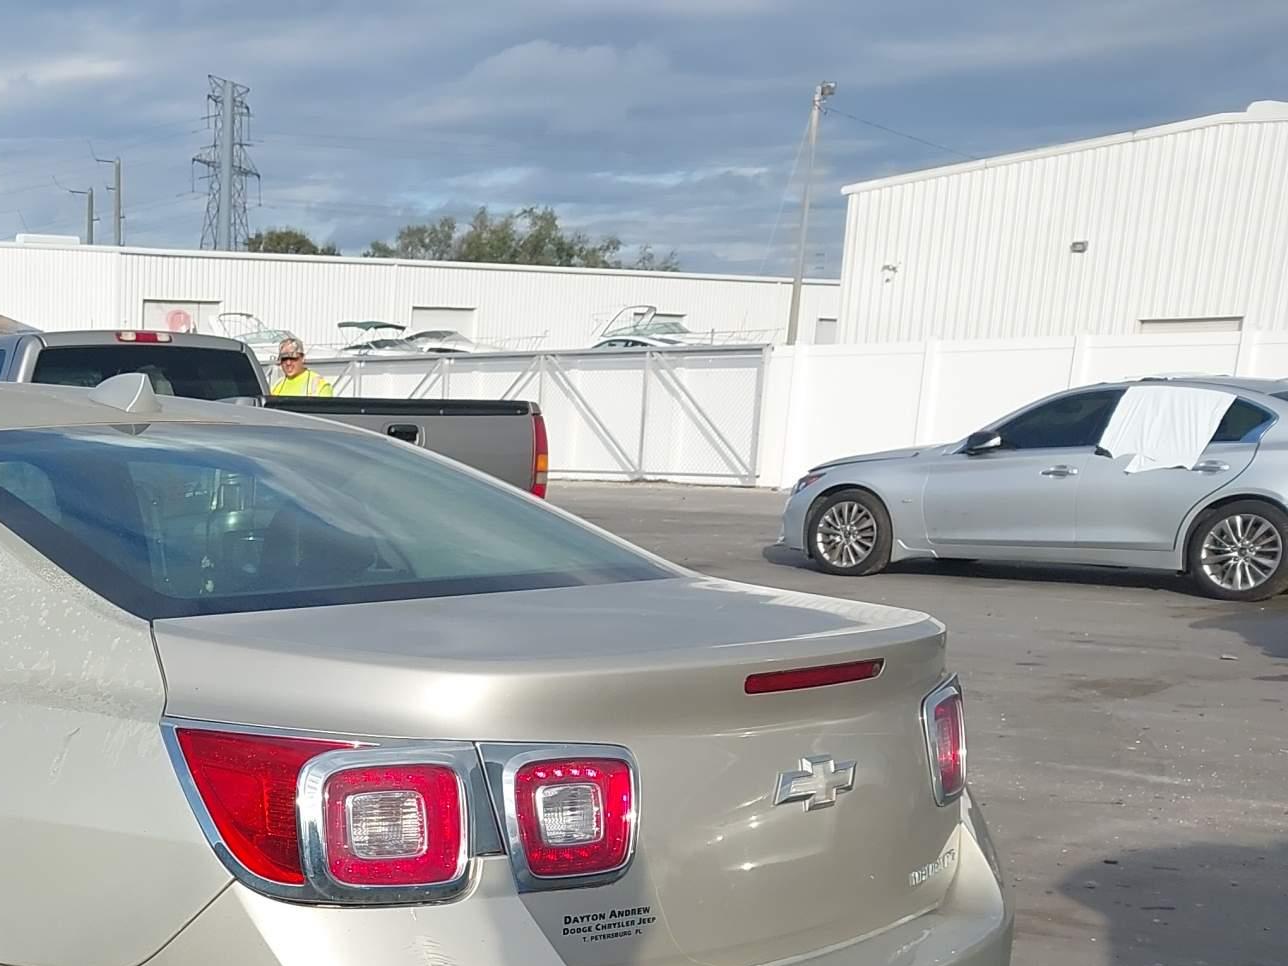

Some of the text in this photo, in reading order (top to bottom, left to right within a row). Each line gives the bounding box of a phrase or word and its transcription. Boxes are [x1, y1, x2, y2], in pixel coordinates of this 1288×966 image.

[564, 906, 650, 925] DAYTON ANDREW
[562, 917, 656, 936] DODGE CHRYSLER JEEP
